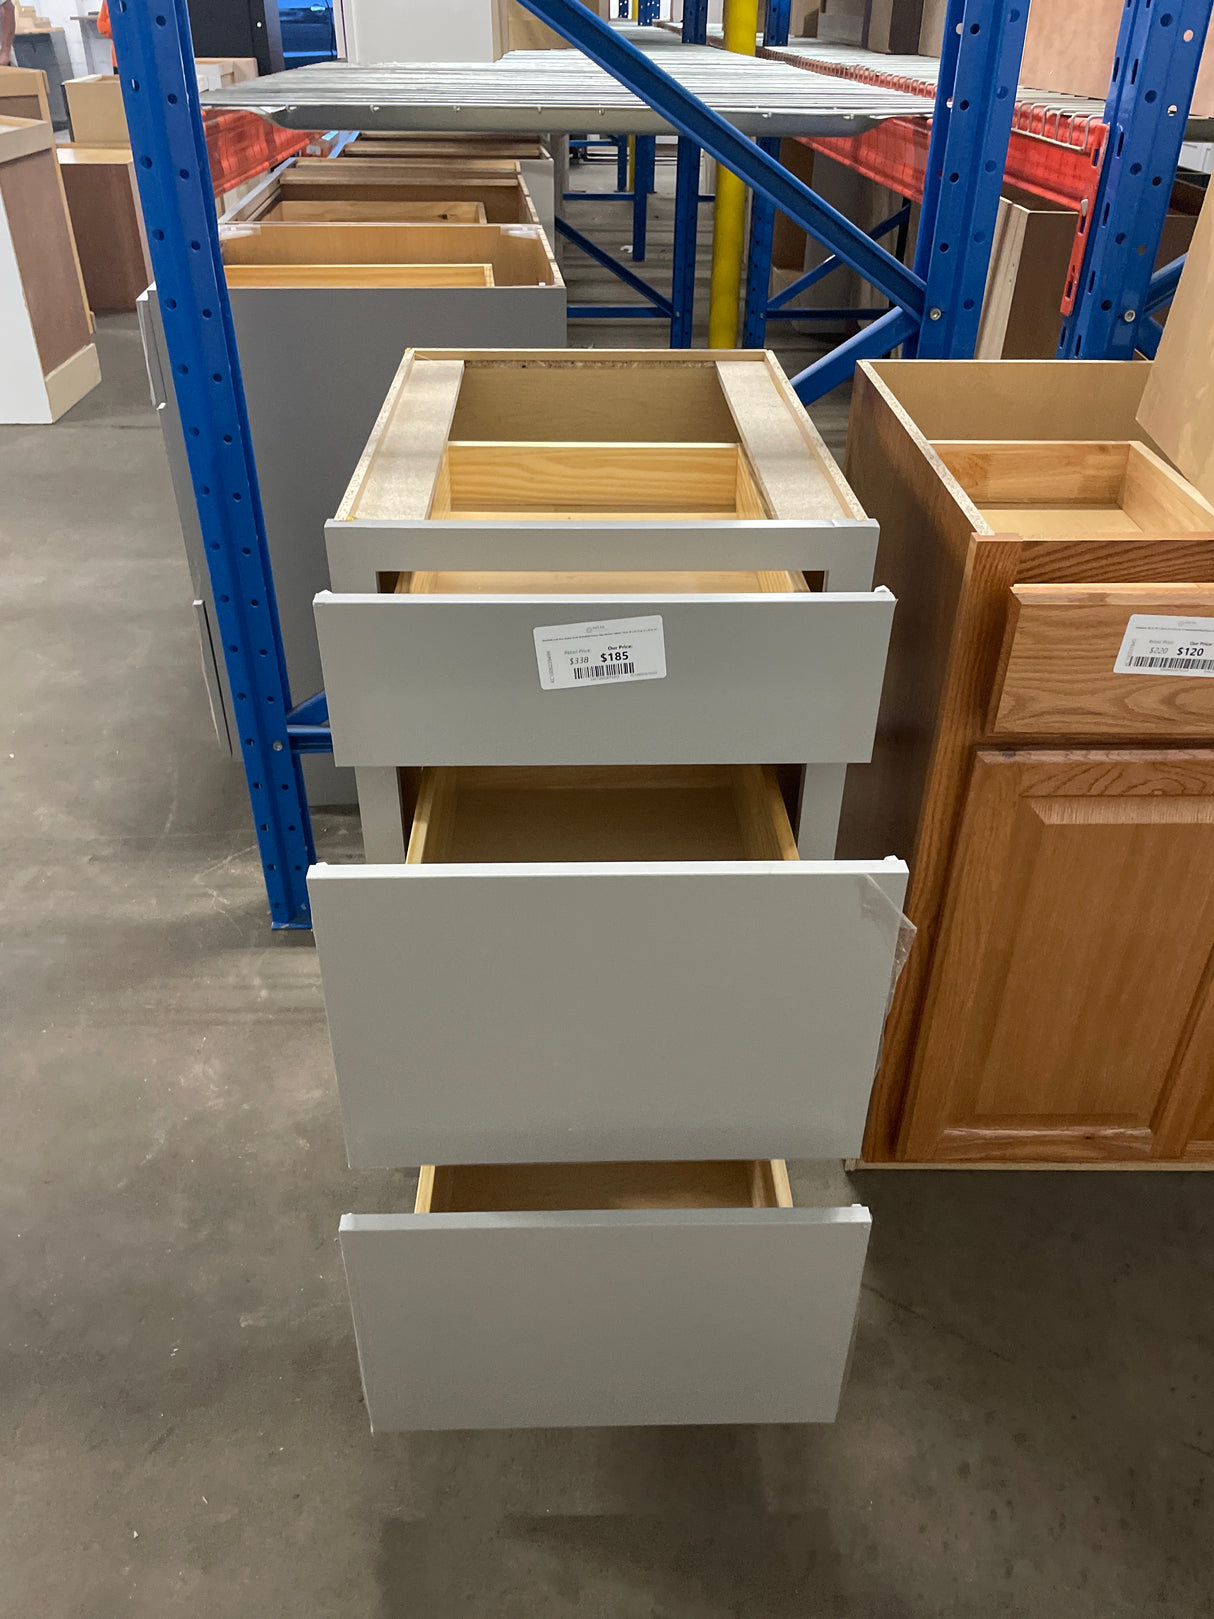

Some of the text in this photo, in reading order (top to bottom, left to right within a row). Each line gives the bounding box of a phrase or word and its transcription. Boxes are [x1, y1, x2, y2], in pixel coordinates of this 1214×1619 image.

[1177, 647, 1204, 656] $120
[569, 656, 589, 665] $338
[600, 651, 629, 663] $185
